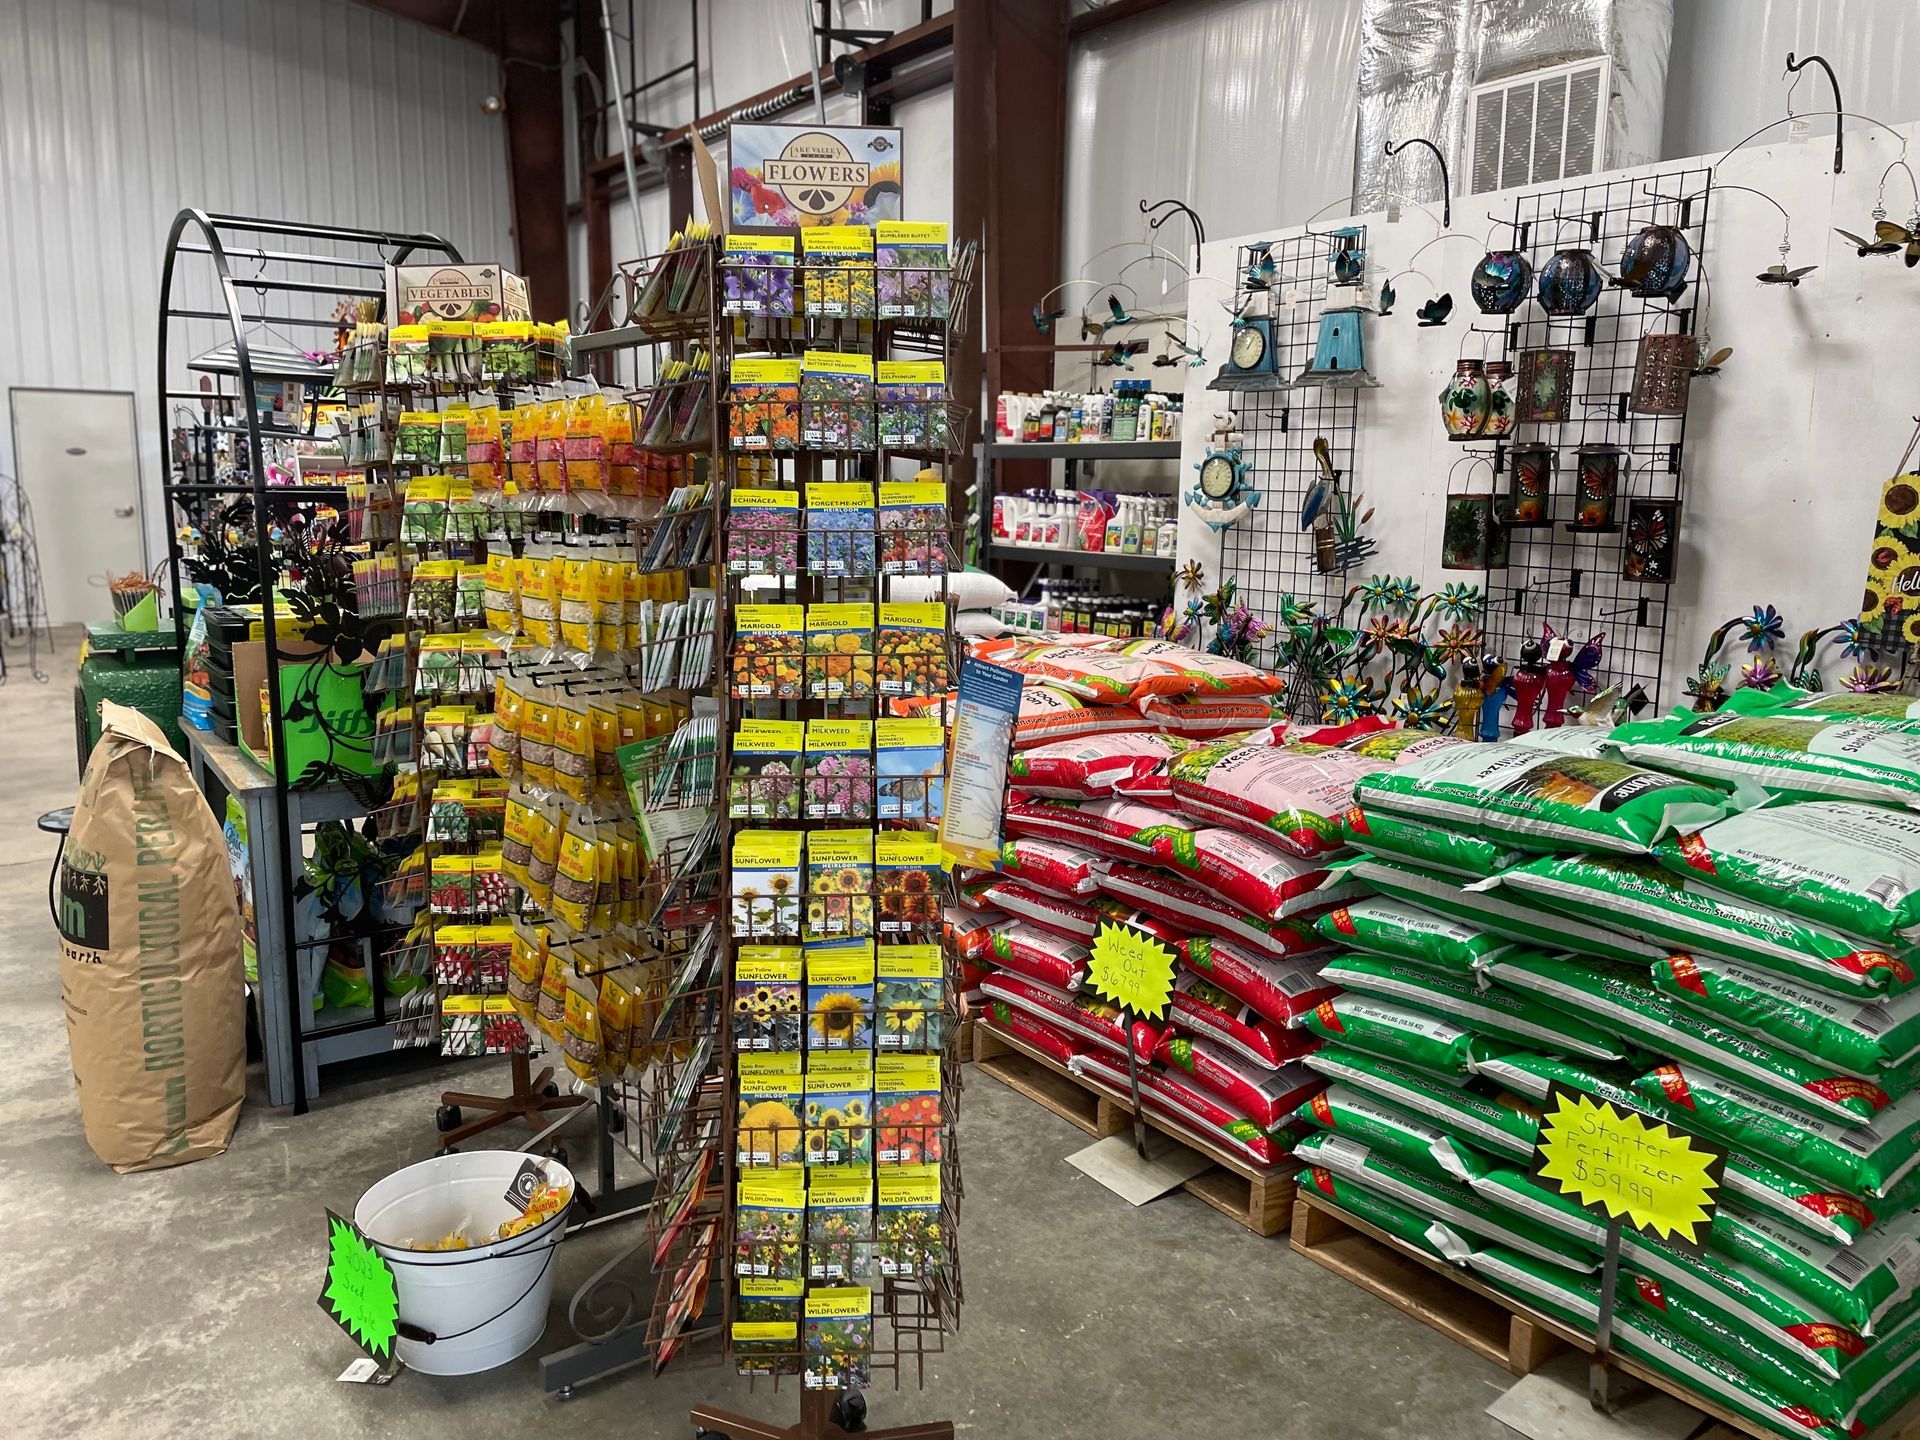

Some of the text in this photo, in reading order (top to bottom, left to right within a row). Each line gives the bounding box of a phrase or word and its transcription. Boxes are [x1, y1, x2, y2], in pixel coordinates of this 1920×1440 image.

[768, 165, 865, 182] FLOWERS
[410, 288, 490, 298] VEGETABLES
[1892, 571, 1920, 593] Hell
[1032, 690, 1060, 707] Food
[1215, 746, 1259, 769] Weed
[1450, 788, 1465, 797] New
[1668, 894, 1688, 907] New
[1689, 902, 1712, 914] Lawn
[1714, 908, 1746, 923] Starter
[66, 949, 102, 964] earth
[1108, 938, 1144, 961] Weed
[138, 873, 186, 1073] HORTICULTURAL
[1123, 958, 1146, 978] Out
[1726, 967, 1741, 977] NET
[1431, 976, 1525, 1010] New Lawn Fertilizer
[1651, 1002, 1671, 1015] New
[1672, 1010, 1694, 1026] Lawn
[1728, 1035, 1772, 1059] Fertilizer
[1414, 1077, 1503, 1120] New Lawn Starter Fertilizer
[1714, 1082, 1729, 1092] NET
[1729, 1086, 1759, 1105] WEIGHT
[1580, 1111, 1671, 1160] Starter
[1566, 1130, 1684, 1185] Fertilizer
[1727, 1151, 1764, 1172] ertilizer
[1399, 1167, 1414, 1178] New
[1414, 1172, 1432, 1185] Lawn
[1433, 1182, 1459, 1196] Starter
[1573, 1158, 1653, 1208] $59.99
[345, 1244, 373, 1281] 2023
[343, 1273, 365, 1298] Seed
[357, 1304, 377, 1331] Sale
[1632, 1309, 1651, 1325] New
[1650, 1320, 1673, 1339] Lawn
